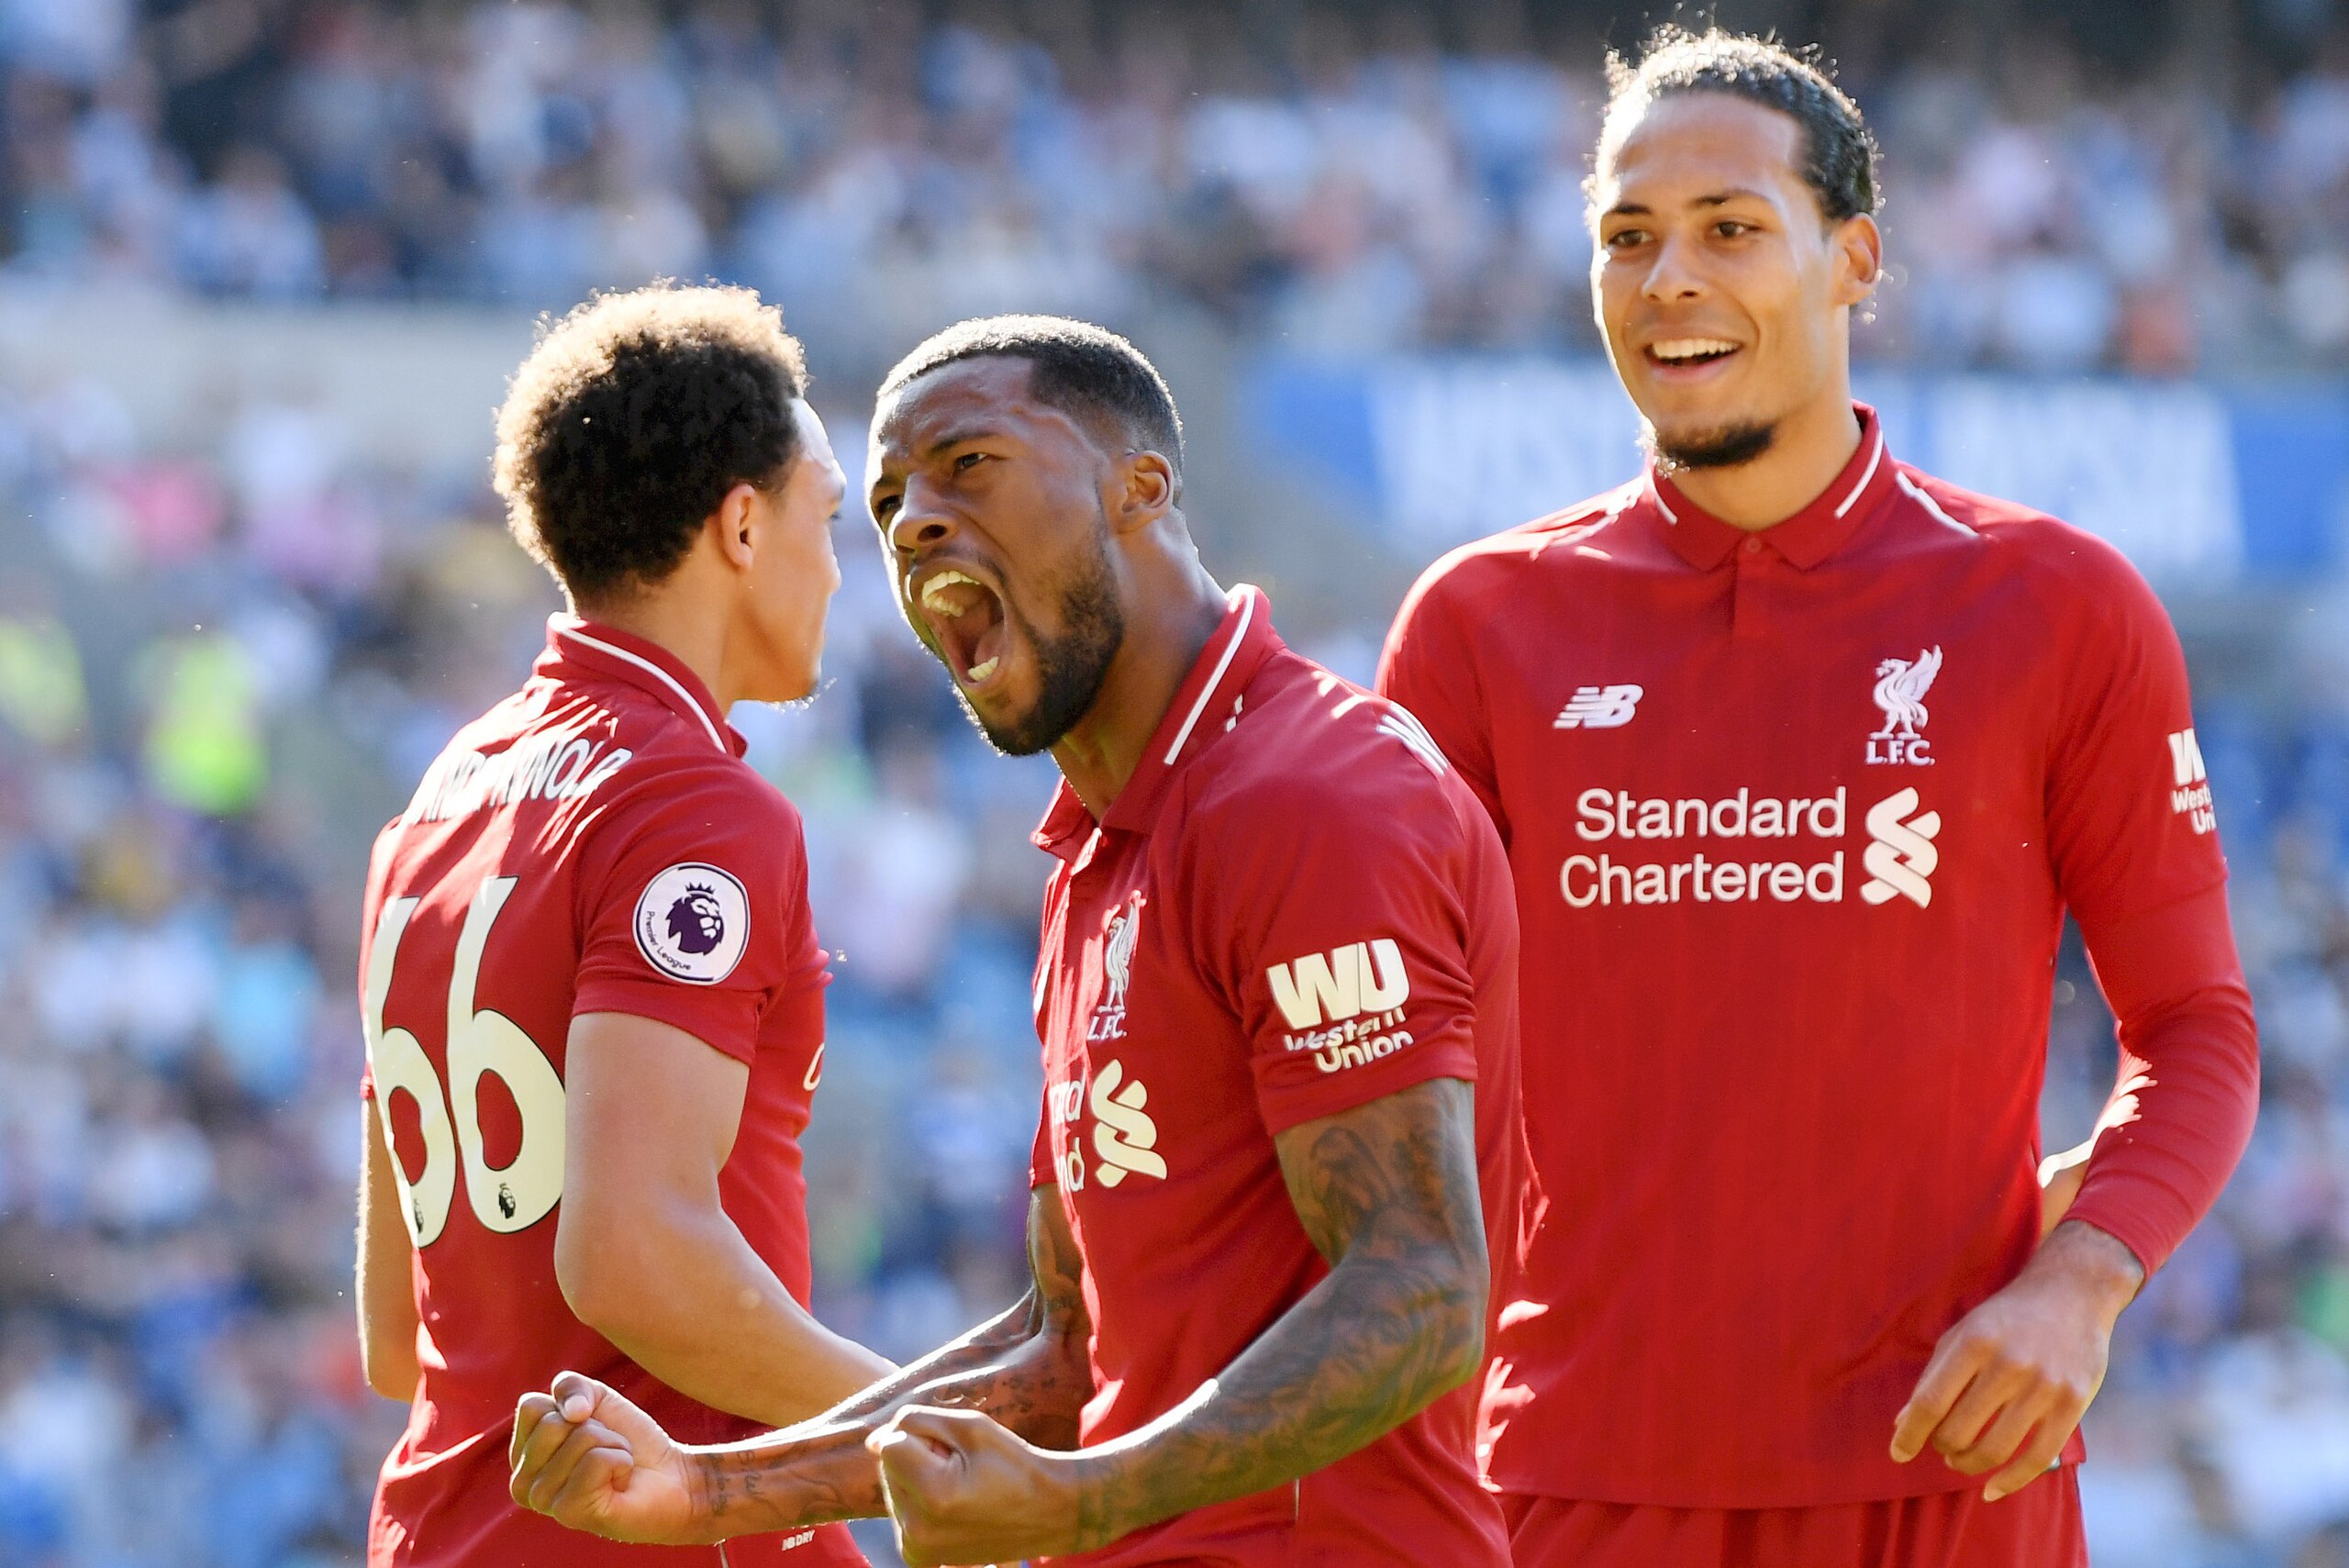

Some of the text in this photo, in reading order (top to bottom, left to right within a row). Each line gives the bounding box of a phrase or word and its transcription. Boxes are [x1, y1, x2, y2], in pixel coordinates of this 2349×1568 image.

[1553, 684, 1644, 729] NB
[1575, 786, 1846, 841] Standard
[1561, 850, 1844, 907] Chartered
[645, 910, 692, 971] Premier League
[1265, 938, 1410, 1029] WU
[363, 875, 566, 1249] 66
[1315, 1030, 1414, 1073] Union
[796, 1529, 815, 1547] DRY
